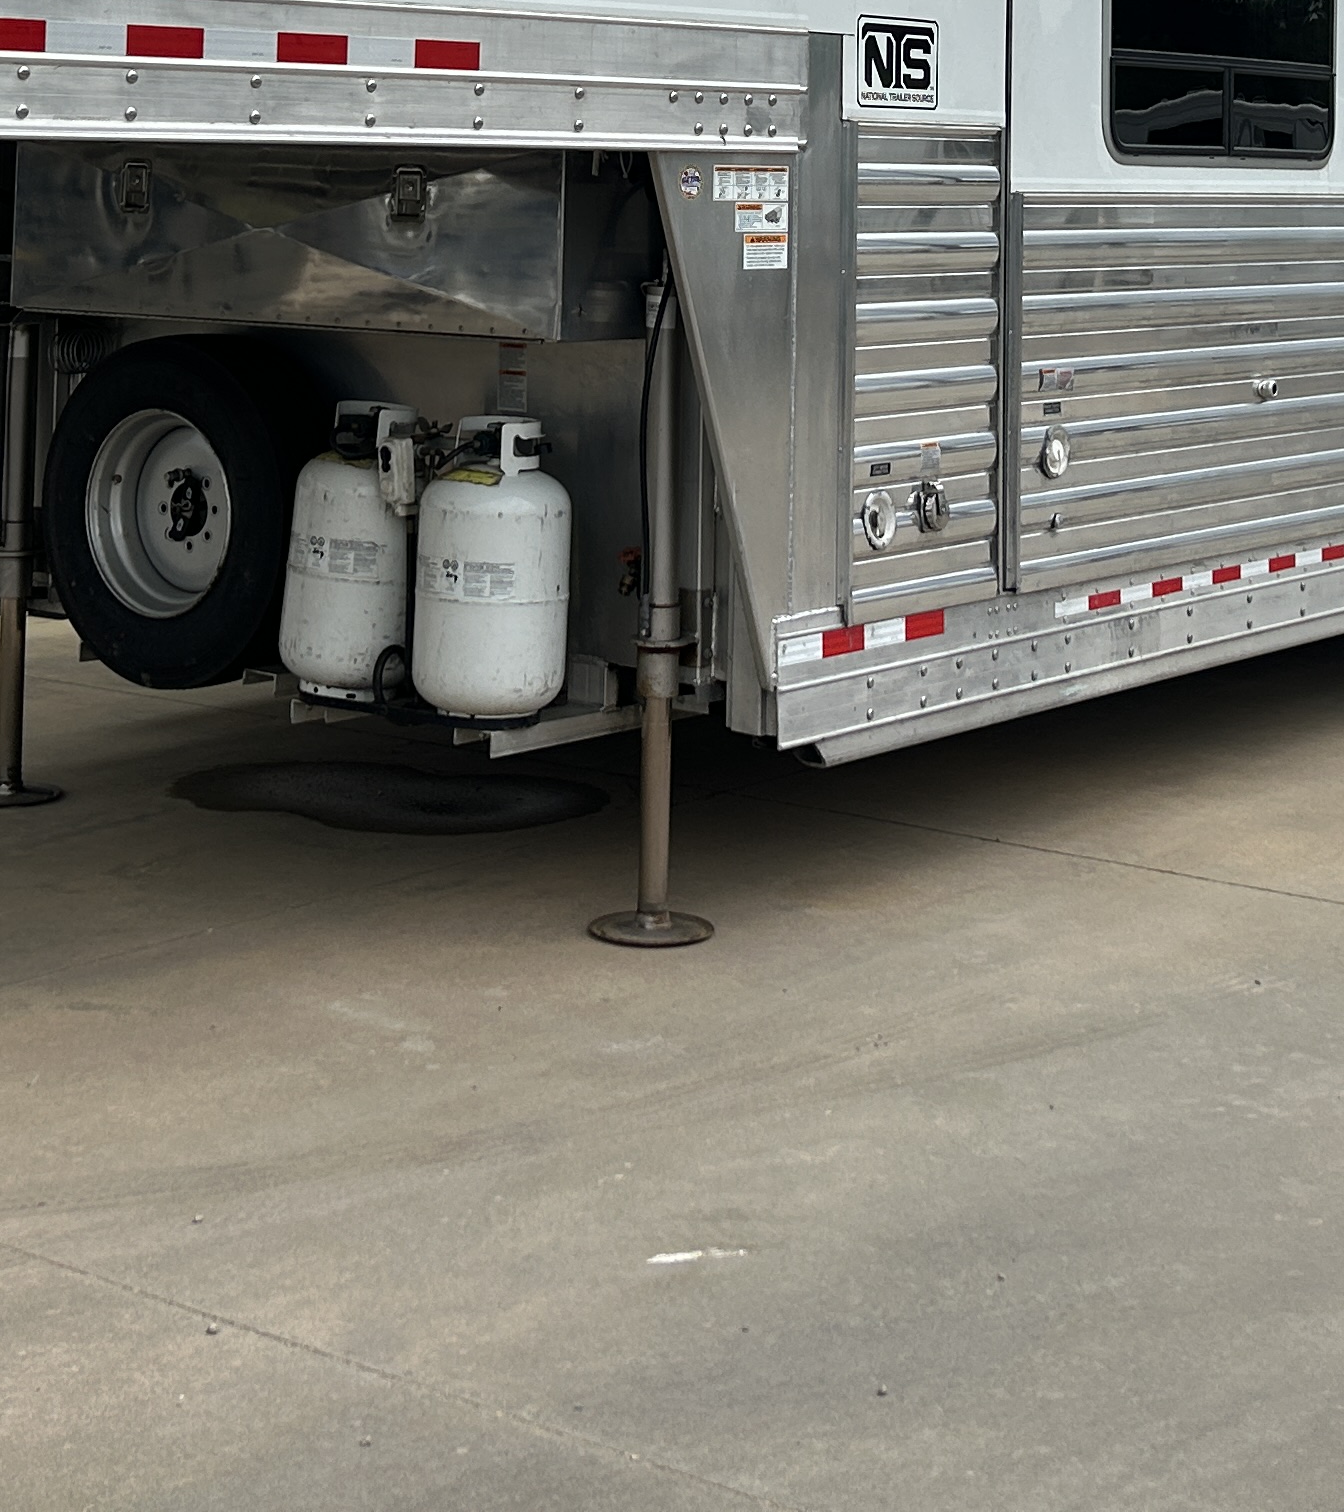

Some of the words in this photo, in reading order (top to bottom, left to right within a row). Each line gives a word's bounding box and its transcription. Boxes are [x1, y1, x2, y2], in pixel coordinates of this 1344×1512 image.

[862, 23, 935, 90] NTS
[861, 92, 888, 101] NATIONAL
[889, 93, 911, 102] TRAILER
[912, 94, 935, 103] SOURCE
